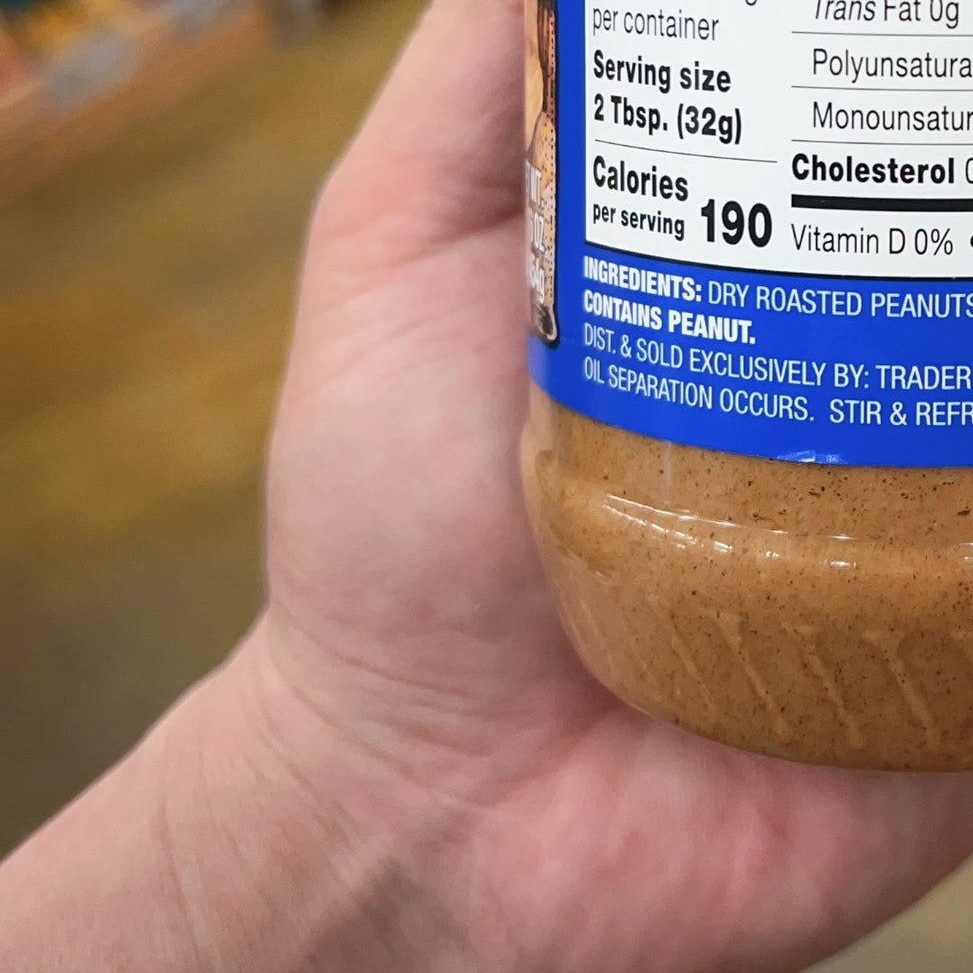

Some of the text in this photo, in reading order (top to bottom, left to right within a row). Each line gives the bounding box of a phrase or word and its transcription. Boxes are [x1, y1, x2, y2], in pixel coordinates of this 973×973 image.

[593, 6, 720, 41] per container
[594, 49, 731, 94] Serving size
[594, 94, 743, 145] 2 Tbsp. (32g)
[593, 155, 689, 202] Calories
[791, 153, 955, 184] Cholesterol
[593, 198, 773, 248] per serving 190
[791, 223, 879, 255] Vitamin
[889, 228, 906, 255] D
[914, 228, 953, 256] 0%
[584, 255, 702, 302] INGREDIENTS:
[708, 281, 750, 308] DRY
[756, 286, 862, 316] ROASTED
[584, 289, 756, 344] CONTAINS PEANUT.
[584, 322, 616, 354] DIST.
[620, 335, 632, 358] &
[636, 337, 683, 368] SOLD
[690, 348, 826, 387] EXCLUSIVELY
[834, 363, 869, 389] BY:
[876, 364, 971, 390] TRADER
[584, 356, 605, 384] OIL
[608, 365, 713, 410] SEPARATION
[720, 387, 814, 422] OCCURS.
[829, 398, 881, 425] STIR
[890, 401, 907, 426] &
